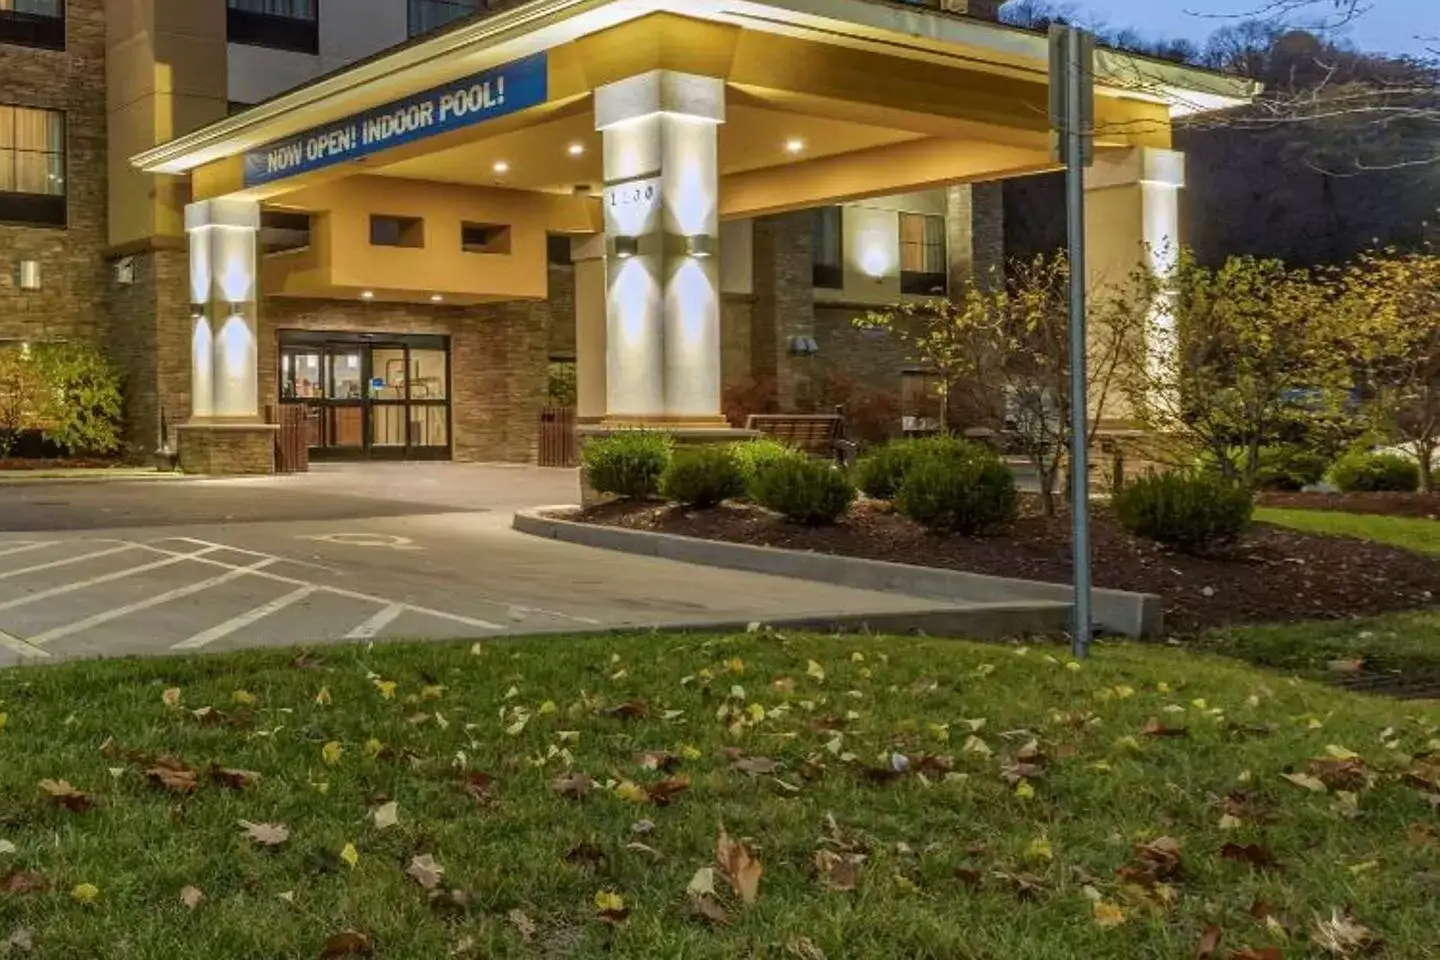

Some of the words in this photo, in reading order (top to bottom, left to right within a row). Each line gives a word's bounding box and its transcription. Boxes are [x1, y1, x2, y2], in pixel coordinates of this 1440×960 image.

[267, 142, 302, 172] NOW
[306, 126, 357, 160] OPEN!
[363, 100, 433, 145] INDOOR
[439, 76, 505, 122] POOL!
